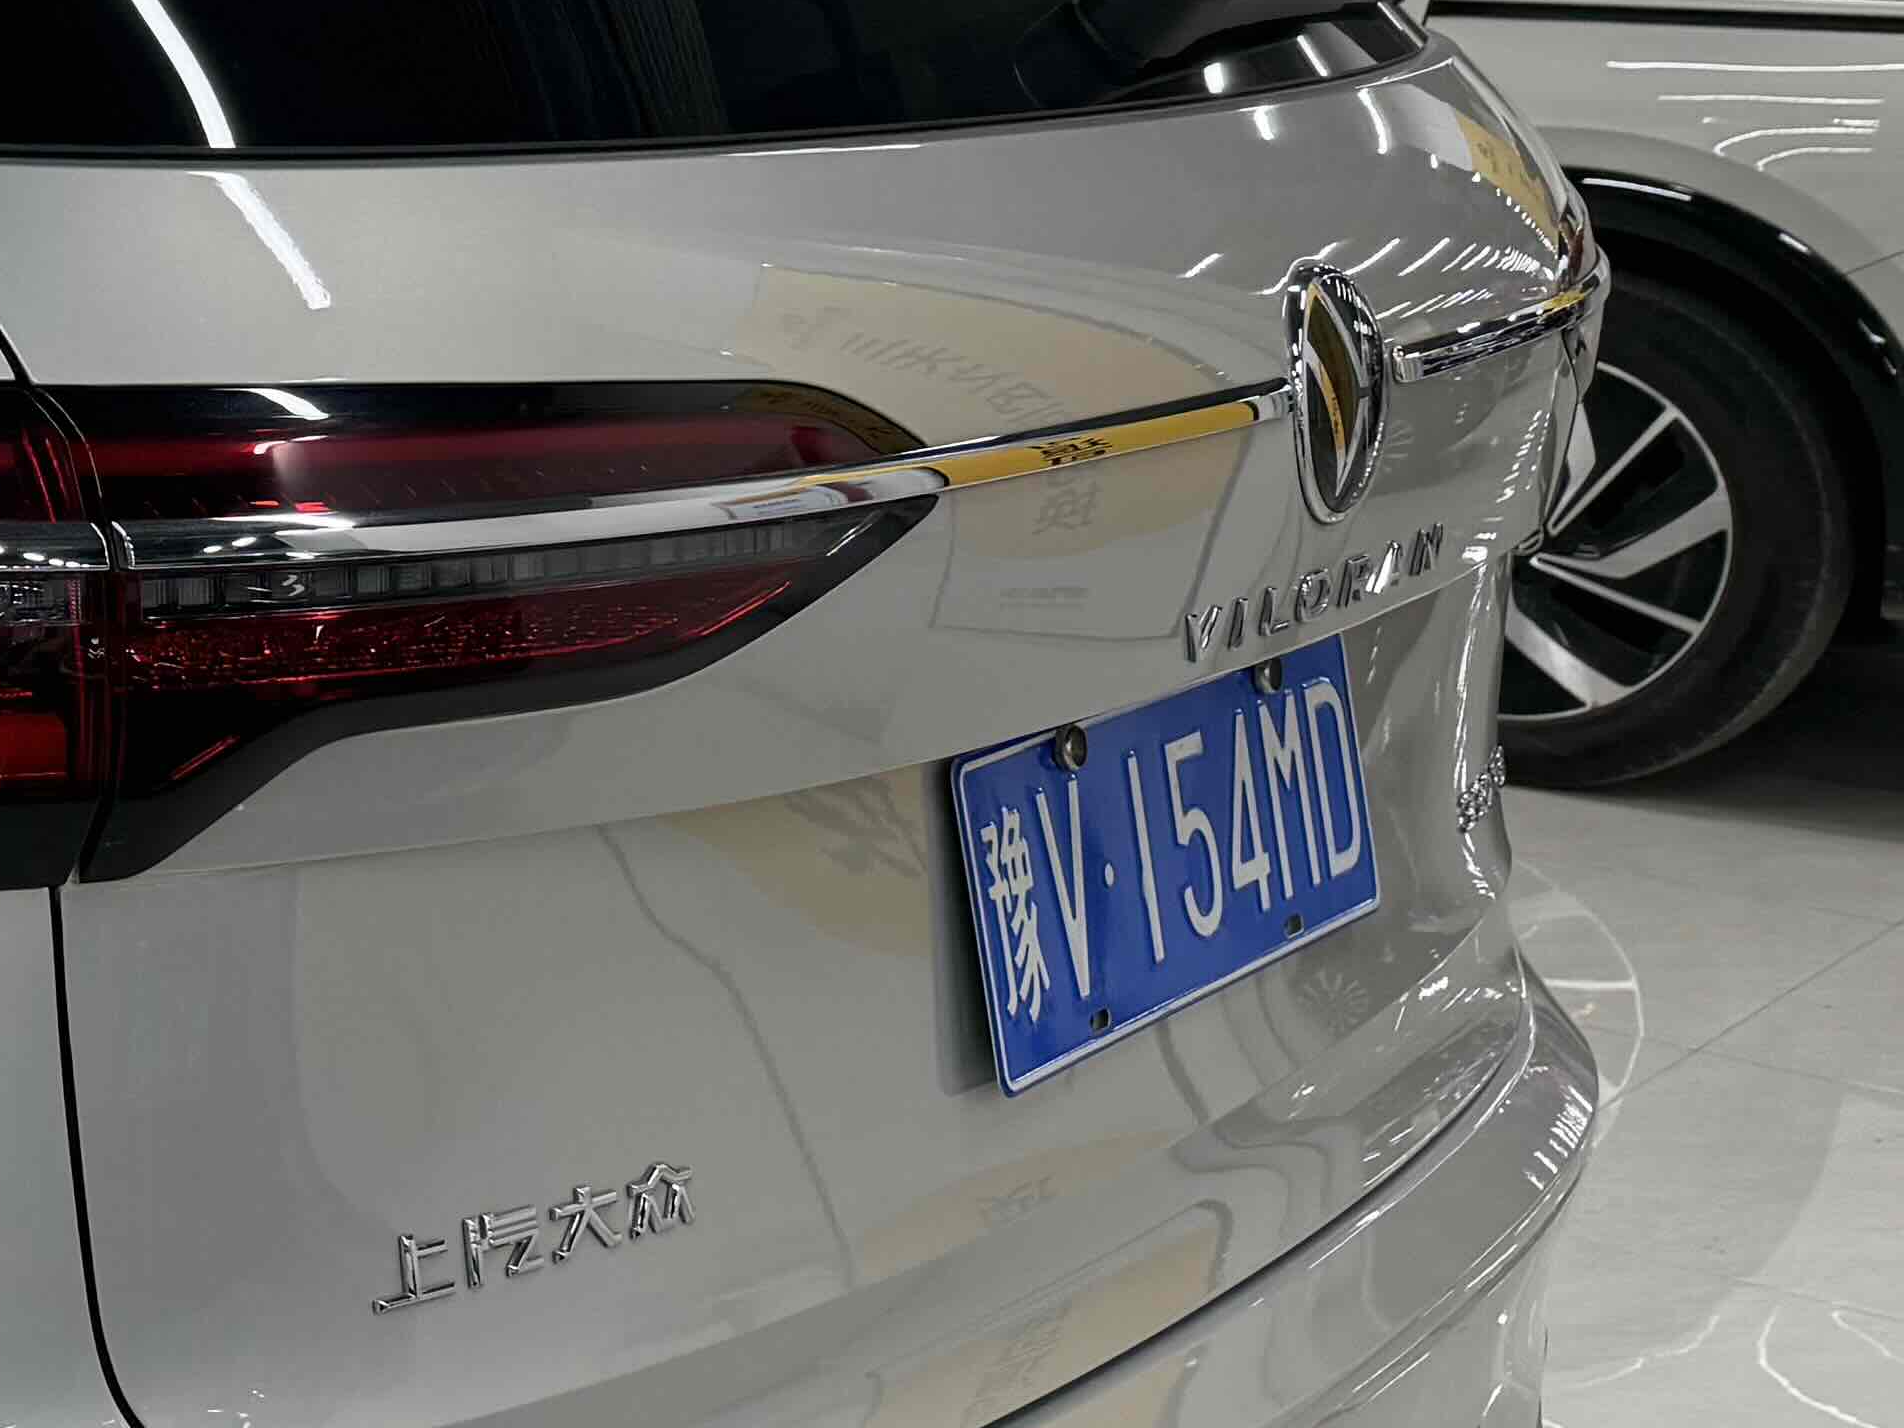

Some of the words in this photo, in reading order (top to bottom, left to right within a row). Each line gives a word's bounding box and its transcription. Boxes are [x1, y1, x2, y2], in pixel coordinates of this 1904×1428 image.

[1185, 521, 1444, 664] VILORAN
[372, 1161, 694, 1315] 上汽大众
